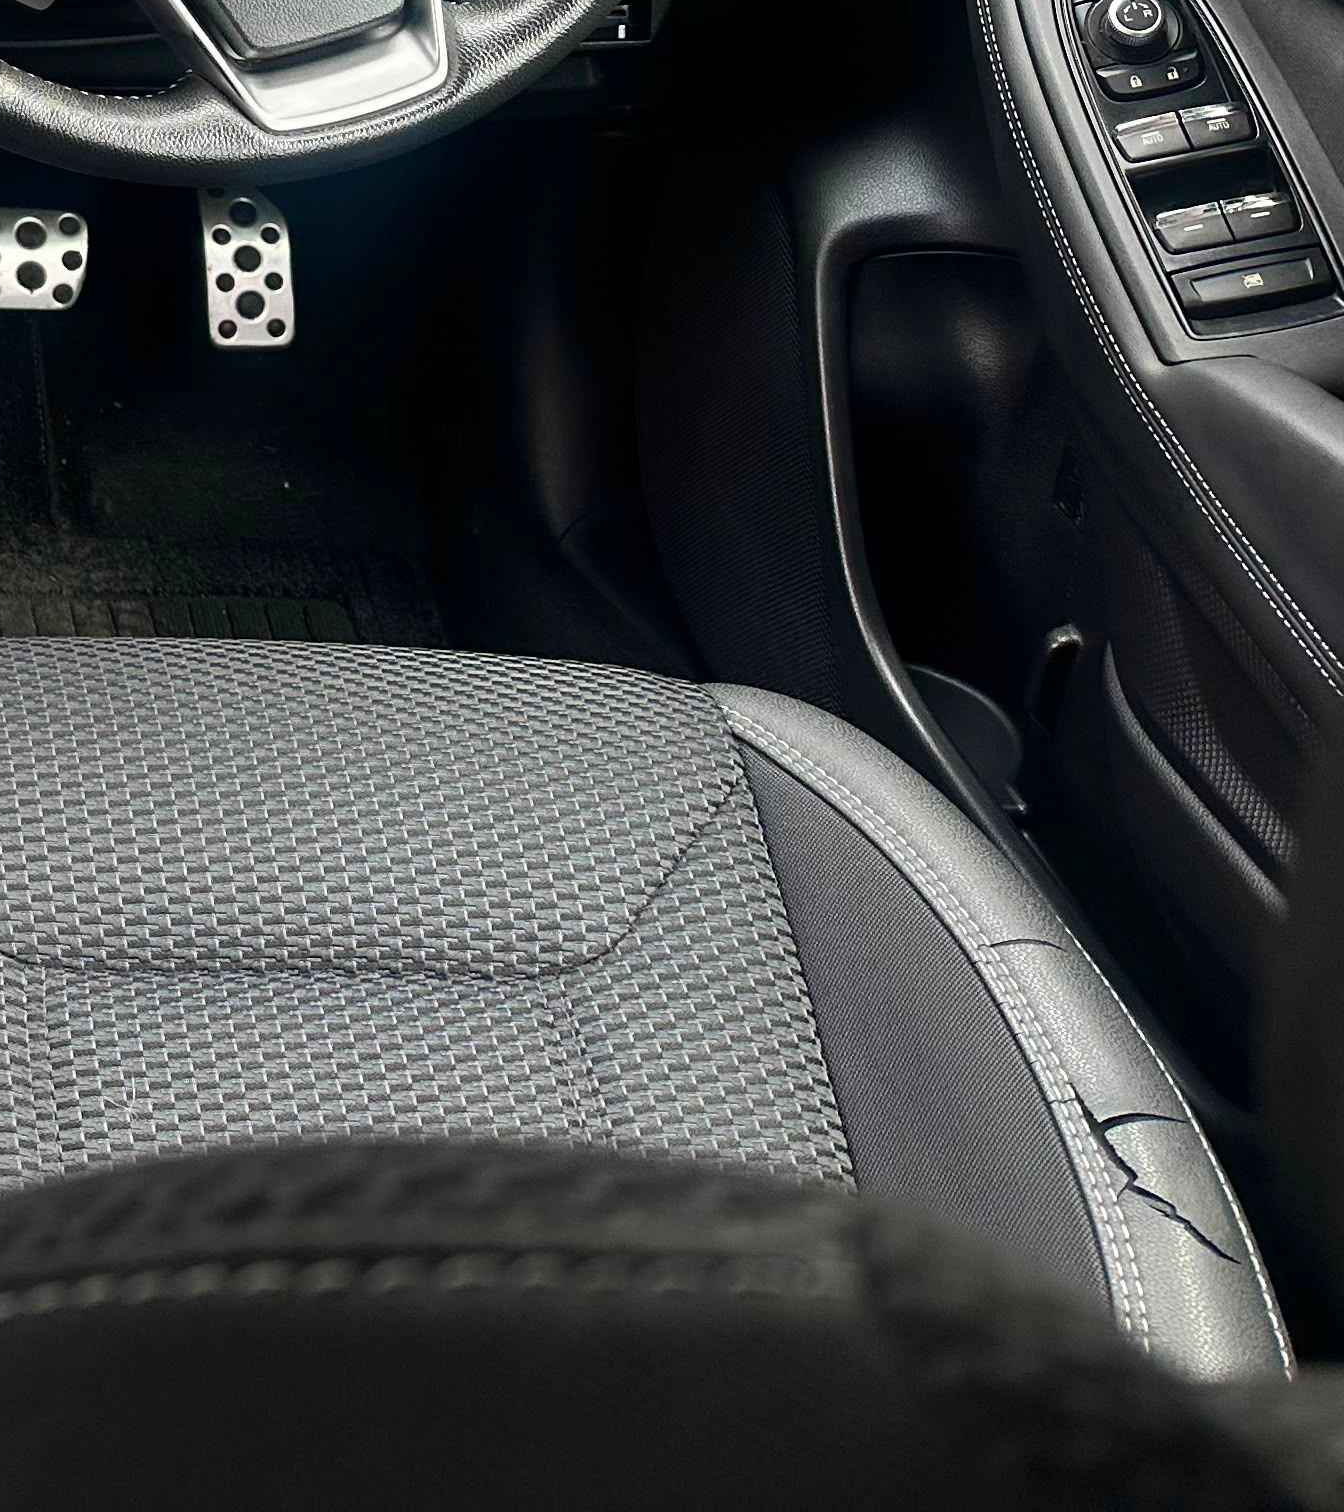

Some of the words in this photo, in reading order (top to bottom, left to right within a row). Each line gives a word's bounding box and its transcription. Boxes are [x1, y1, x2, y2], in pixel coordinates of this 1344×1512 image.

[1143, 8, 1154, 18] R
[1207, 120, 1231, 132] AUTO
[1142, 134, 1164, 146] AUTO
